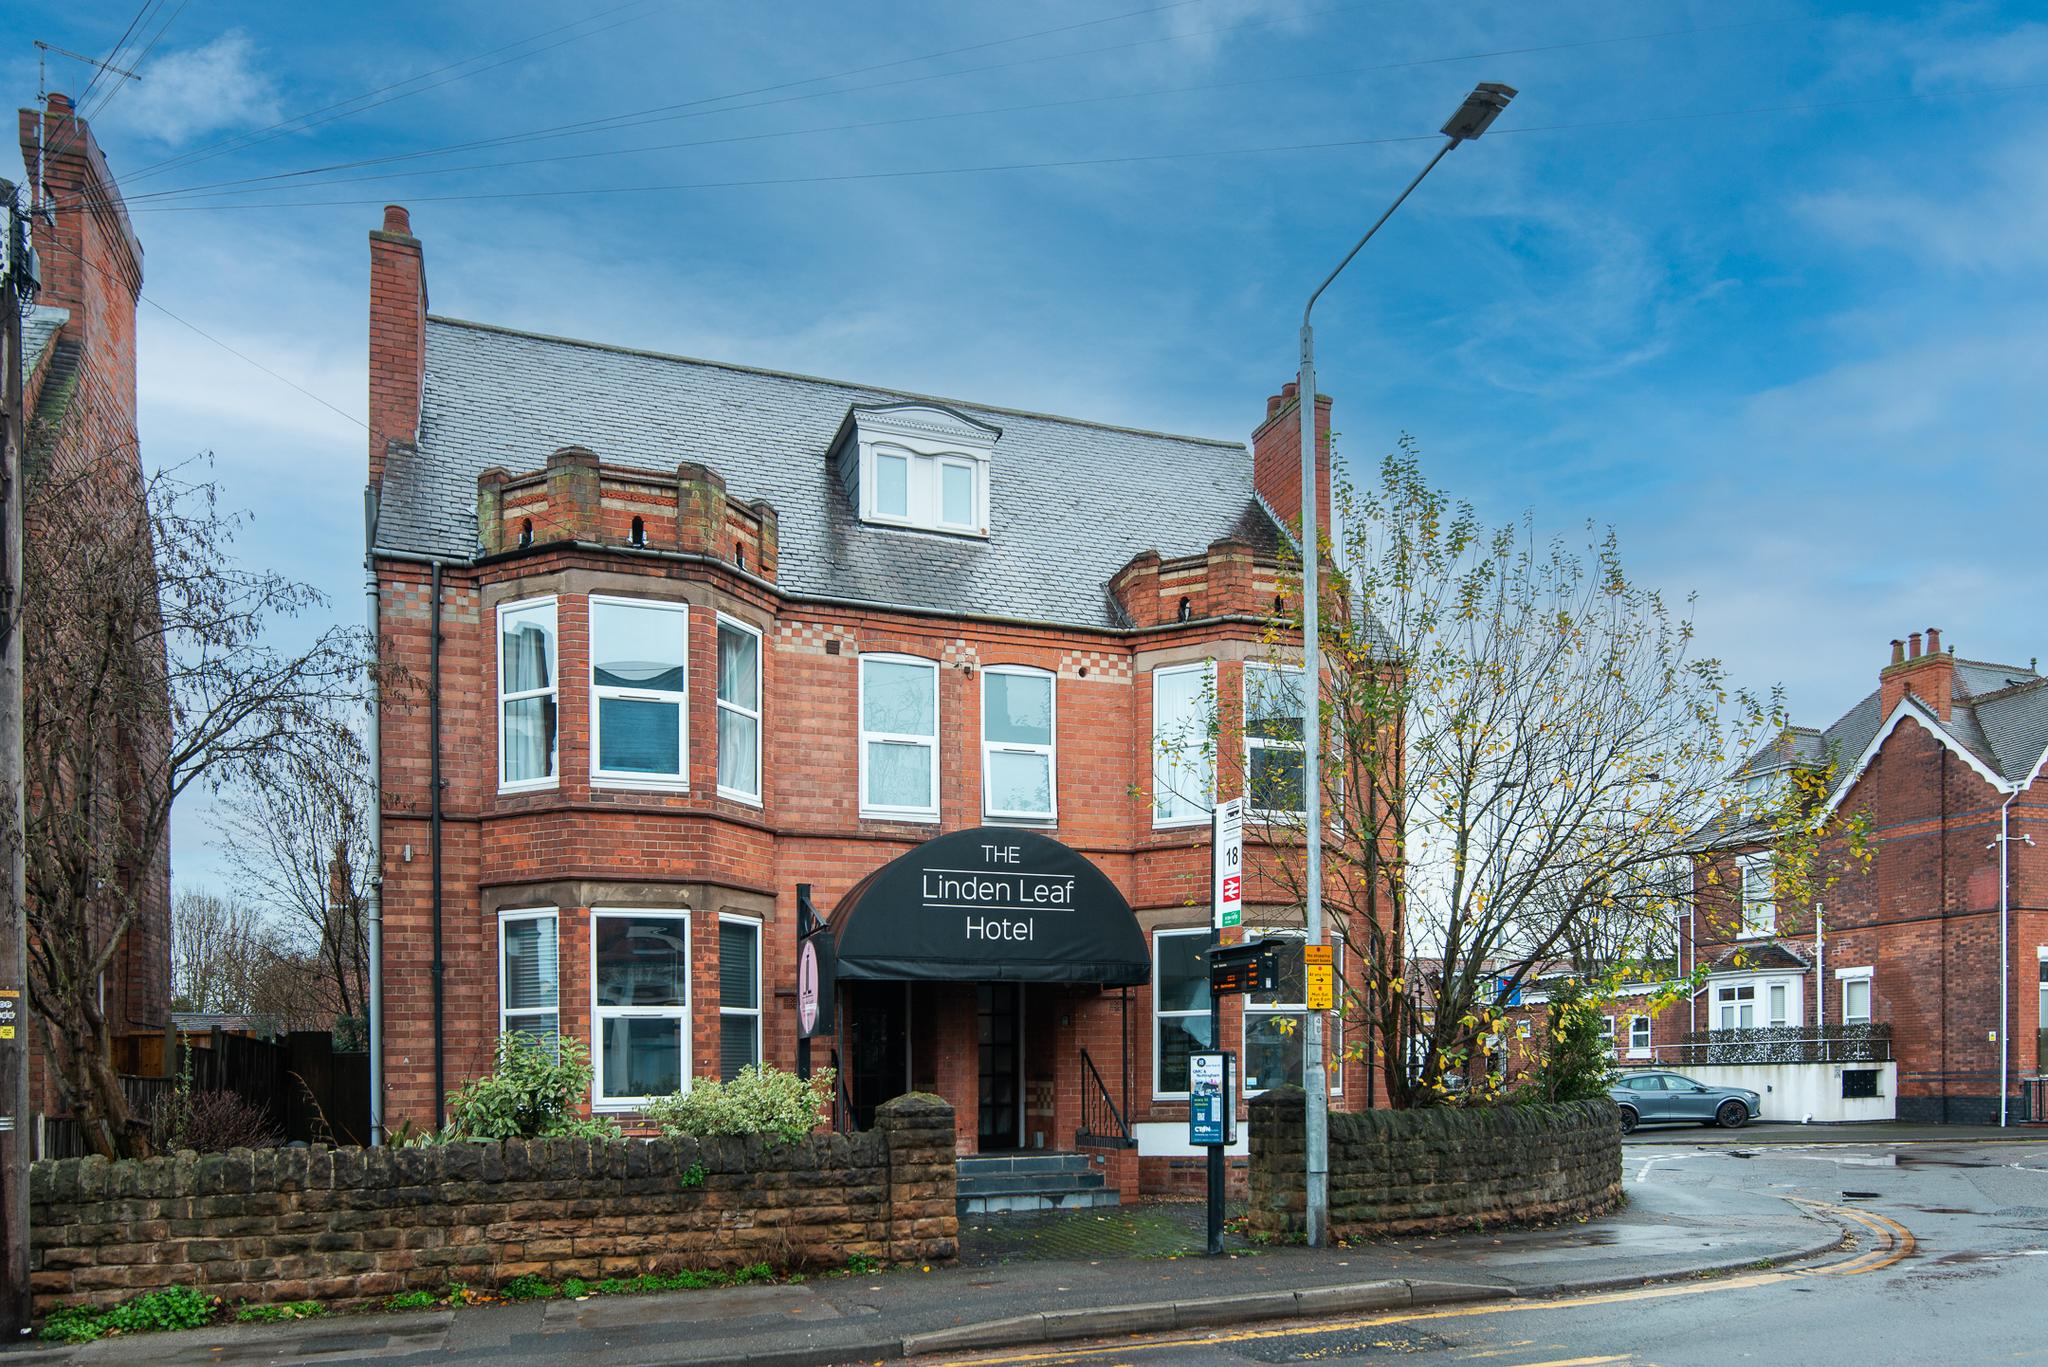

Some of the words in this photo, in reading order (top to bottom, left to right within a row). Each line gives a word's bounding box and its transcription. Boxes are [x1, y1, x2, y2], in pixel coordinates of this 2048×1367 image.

[981, 845, 1020, 864] THE
[1226, 846, 1239, 867] 18
[923, 874, 1011, 902] Linden
[1020, 880, 1075, 904] Leaf
[966, 916, 1034, 941] Hotel
